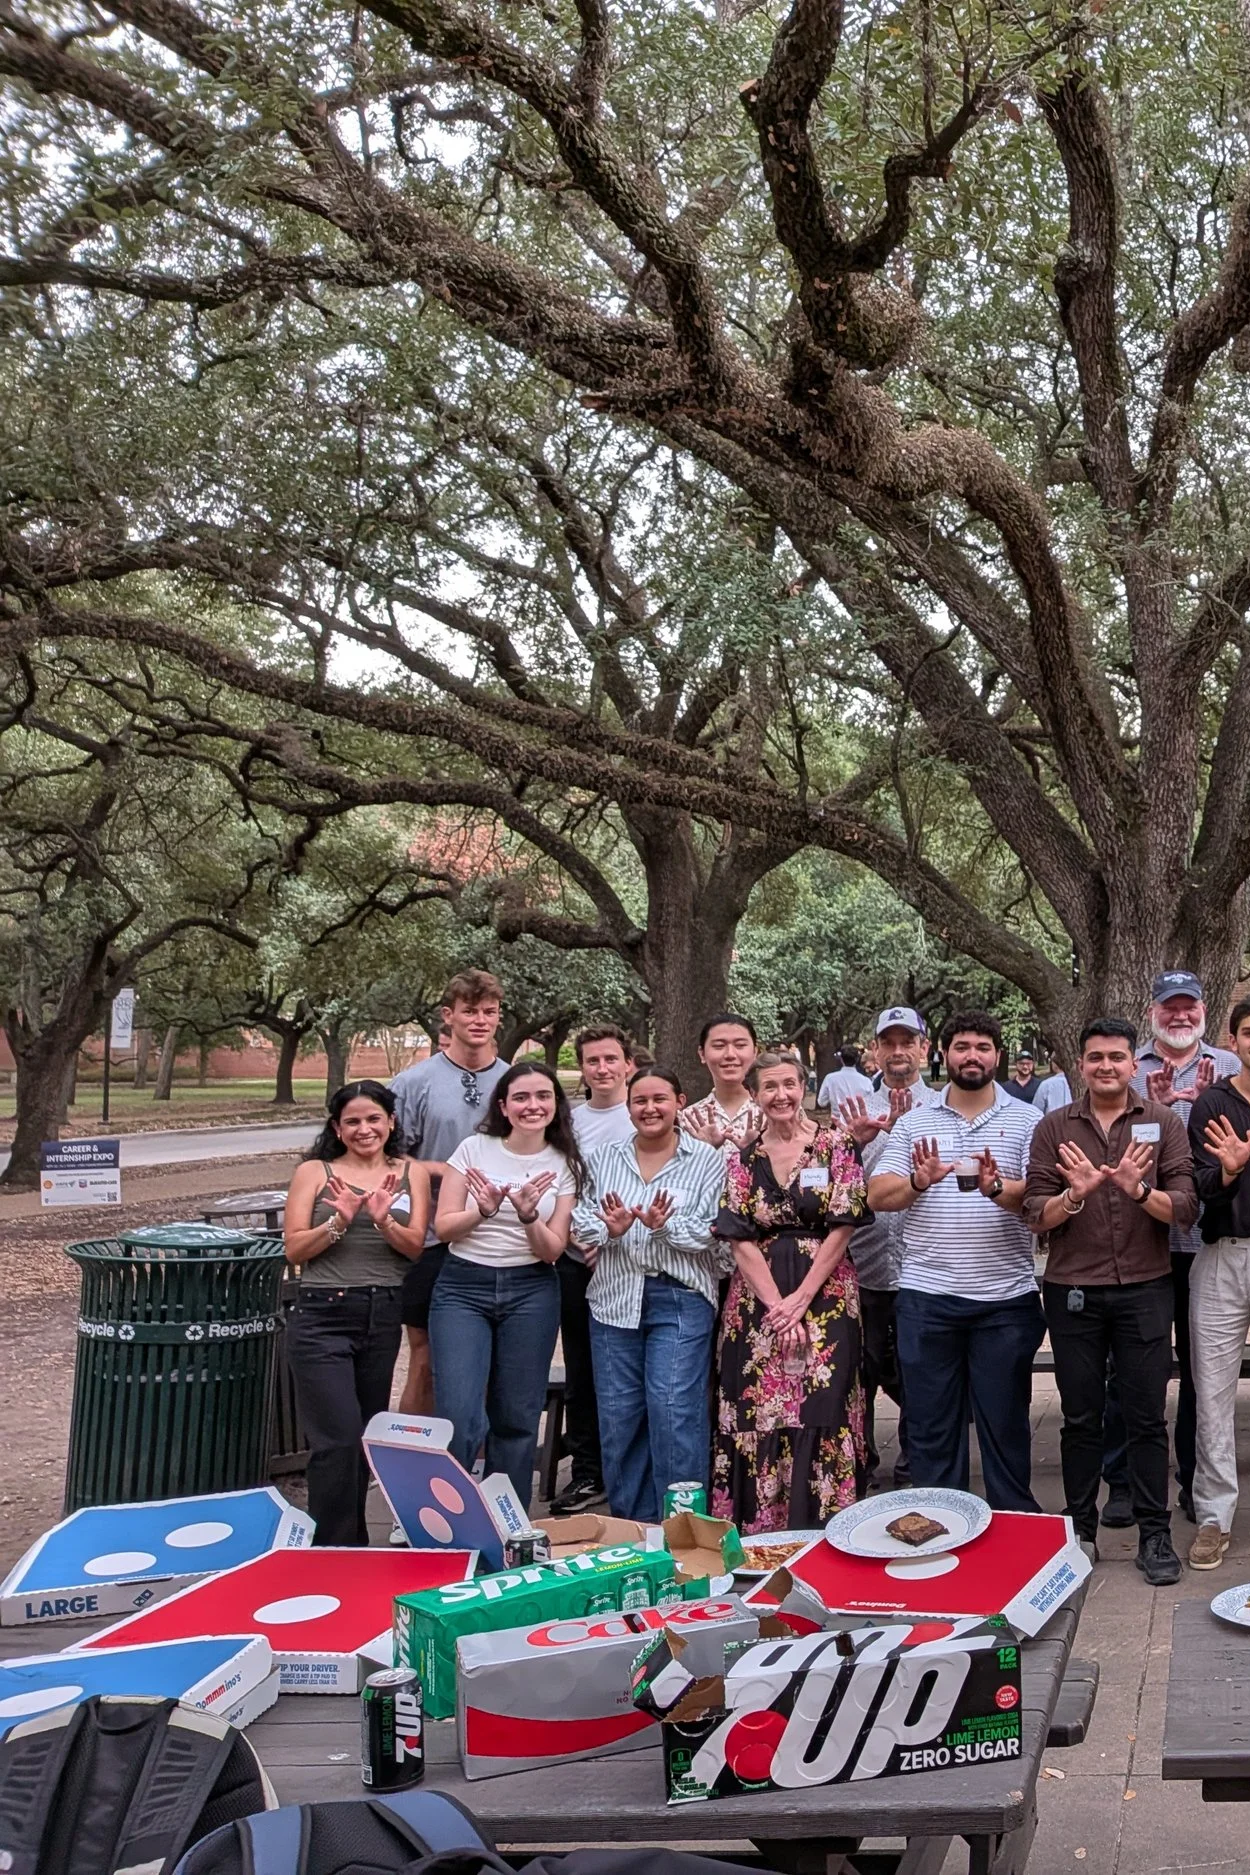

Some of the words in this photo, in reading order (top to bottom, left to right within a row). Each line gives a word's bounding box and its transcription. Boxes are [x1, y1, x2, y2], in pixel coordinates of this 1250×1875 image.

[46, 1154, 92, 1162] INTERNSHIP
[93, 1153, 114, 1161] EXPO
[62, 1145, 91, 1153] CAREER
[78, 1318, 115, 1340] Recycle
[208, 1319, 264, 1339] Recycle
[438, 1547, 636, 1603] Sprite
[26, 1595, 99, 1619] LARGE
[997, 1647, 1017, 1663] 12
[290, 1664, 310, 1672] YOUR
[311, 1664, 340, 1672] DRIVER.
[382, 1696, 392, 1728] LEMON
[395, 1693, 422, 1763] 7UP
[667, 1652, 971, 1805] 7UP
[946, 1731, 974, 1746] LIME
[977, 1725, 1019, 1741] LEMON
[383, 1729, 393, 1756] LIME
[900, 1749, 950, 1771] ZERO
[954, 1738, 1019, 1763] SUGAR
